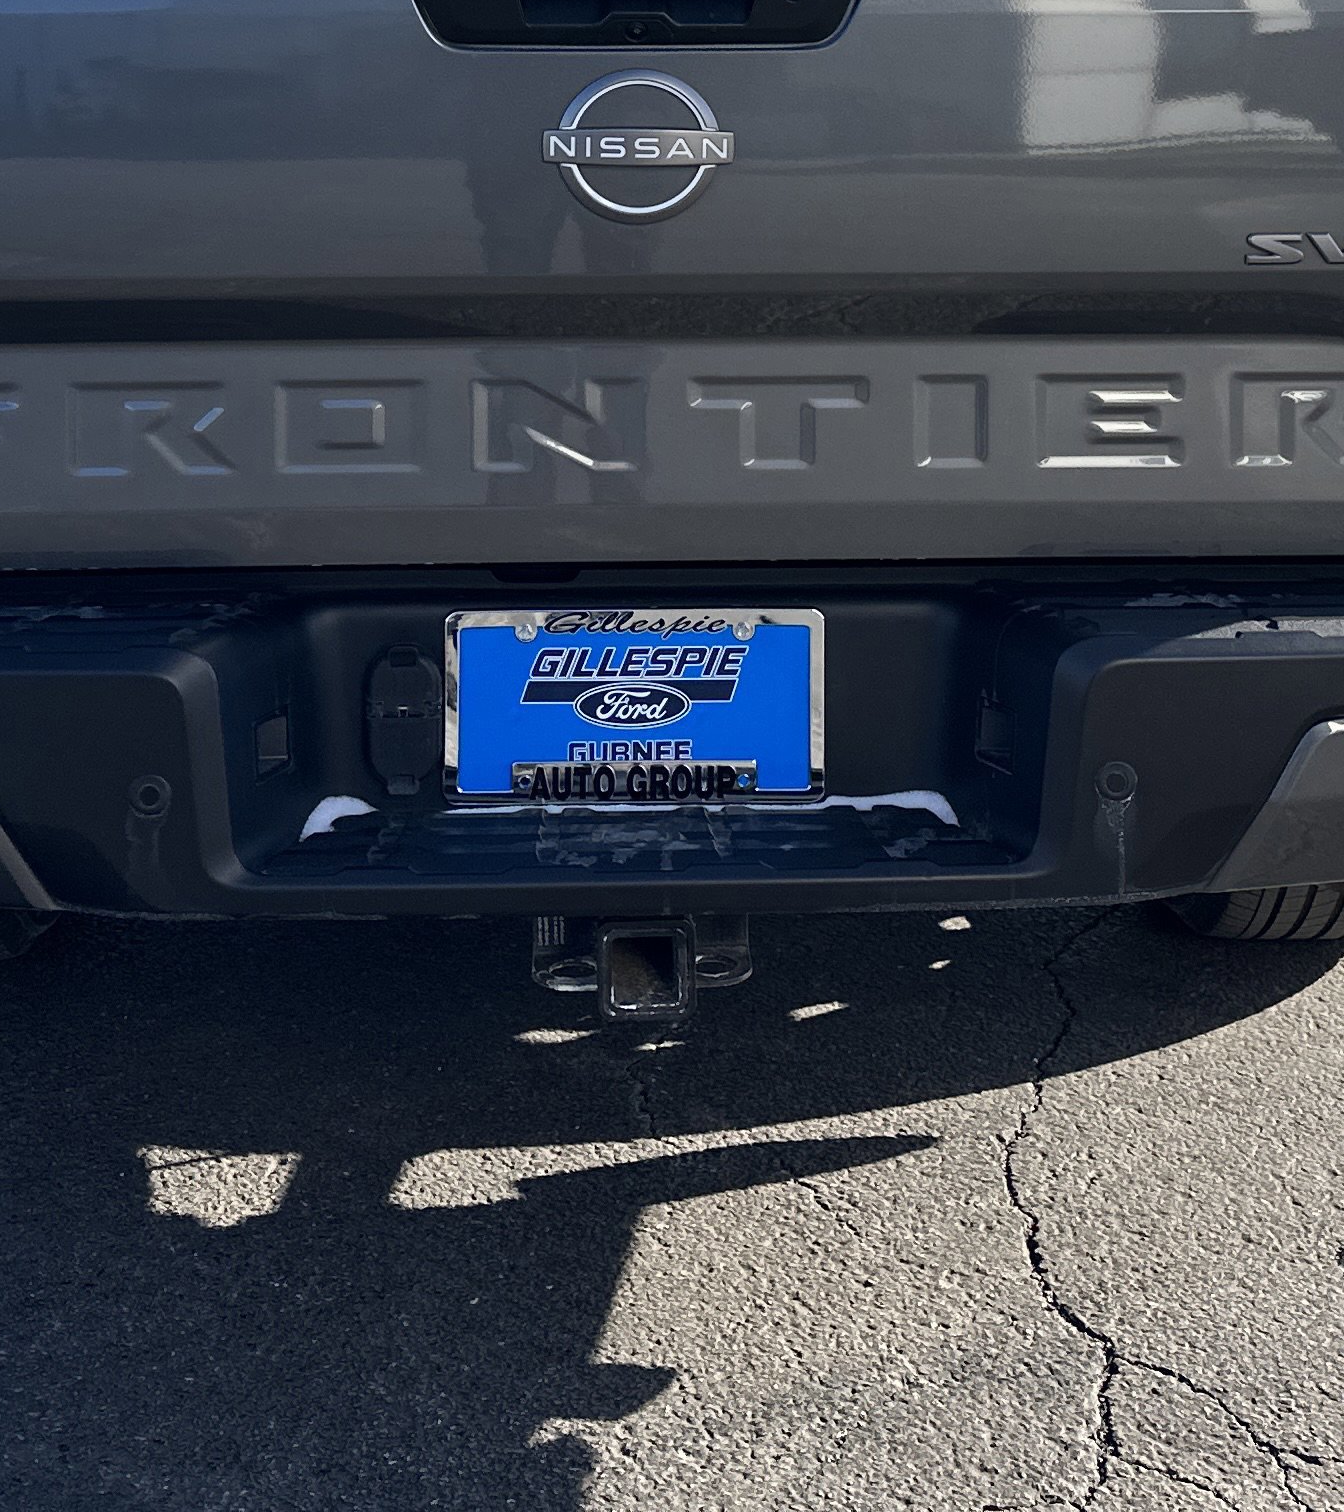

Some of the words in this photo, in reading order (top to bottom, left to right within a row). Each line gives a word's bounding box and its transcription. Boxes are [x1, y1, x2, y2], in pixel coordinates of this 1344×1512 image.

[549, 134, 728, 160] NISSAN
[543, 610, 729, 640] Gillespie
[530, 645, 749, 679] GILLESPIE
[595, 689, 669, 721] Ford
[567, 739, 693, 761] GURNEE
[528, 764, 617, 801] AUTO
[625, 763, 739, 800] GROUP
